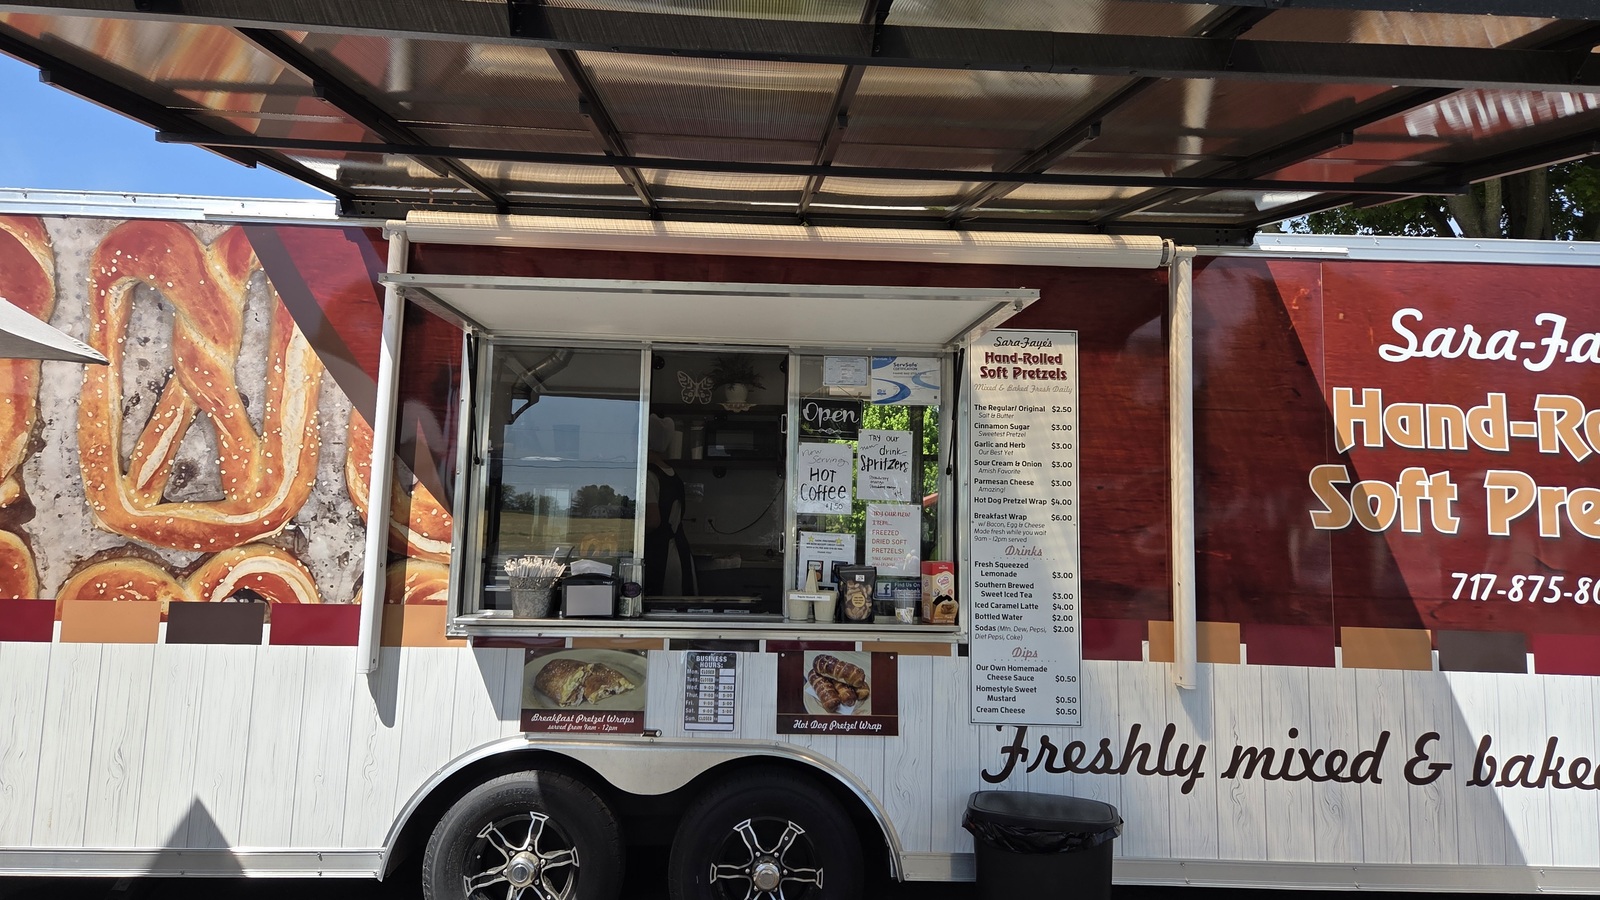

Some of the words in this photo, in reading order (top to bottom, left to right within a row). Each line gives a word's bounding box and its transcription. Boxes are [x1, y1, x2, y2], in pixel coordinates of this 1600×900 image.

[994, 337, 1052, 349] Sara-Faye's
[1379, 308, 1600, 372] Sara-Fa
[985, 352, 1062, 365] Hand-Rolled
[980, 366, 1008, 379] Soft
[1013, 367, 1067, 380] Pretzels
[1030, 385, 1050, 393] Fresh
[1052, 386, 1072, 394] Daily
[802, 402, 859, 427] Open
[860, 455, 909, 473] Spritzers
[810, 467, 836, 482] HOT
[800, 483, 846, 501] Coffee
[1029, 498, 1047, 506] Wrap
[1309, 464, 1460, 534] Soft
[1484, 470, 1600, 539] Pre
[1005, 545, 1042, 556] Drinks
[1012, 647, 1038, 660] Dips
[976, 685, 1013, 693] Homestyle
[531, 713, 574, 722] Breakfast
[575, 714, 604, 723] Pretzel
[606, 715, 635, 724] Wraps
[602, 724, 618, 732] 12pm
[793, 720, 809, 729] Hot
[810, 720, 827, 731] Dog
[829, 721, 857, 731] Pretzel
[859, 722, 882, 731] Wrap
[981, 723, 1206, 794] Freshly
[1221, 730, 1390, 784] mixed
[1404, 732, 1452, 785] &
[1466, 735, 1600, 791] bake
